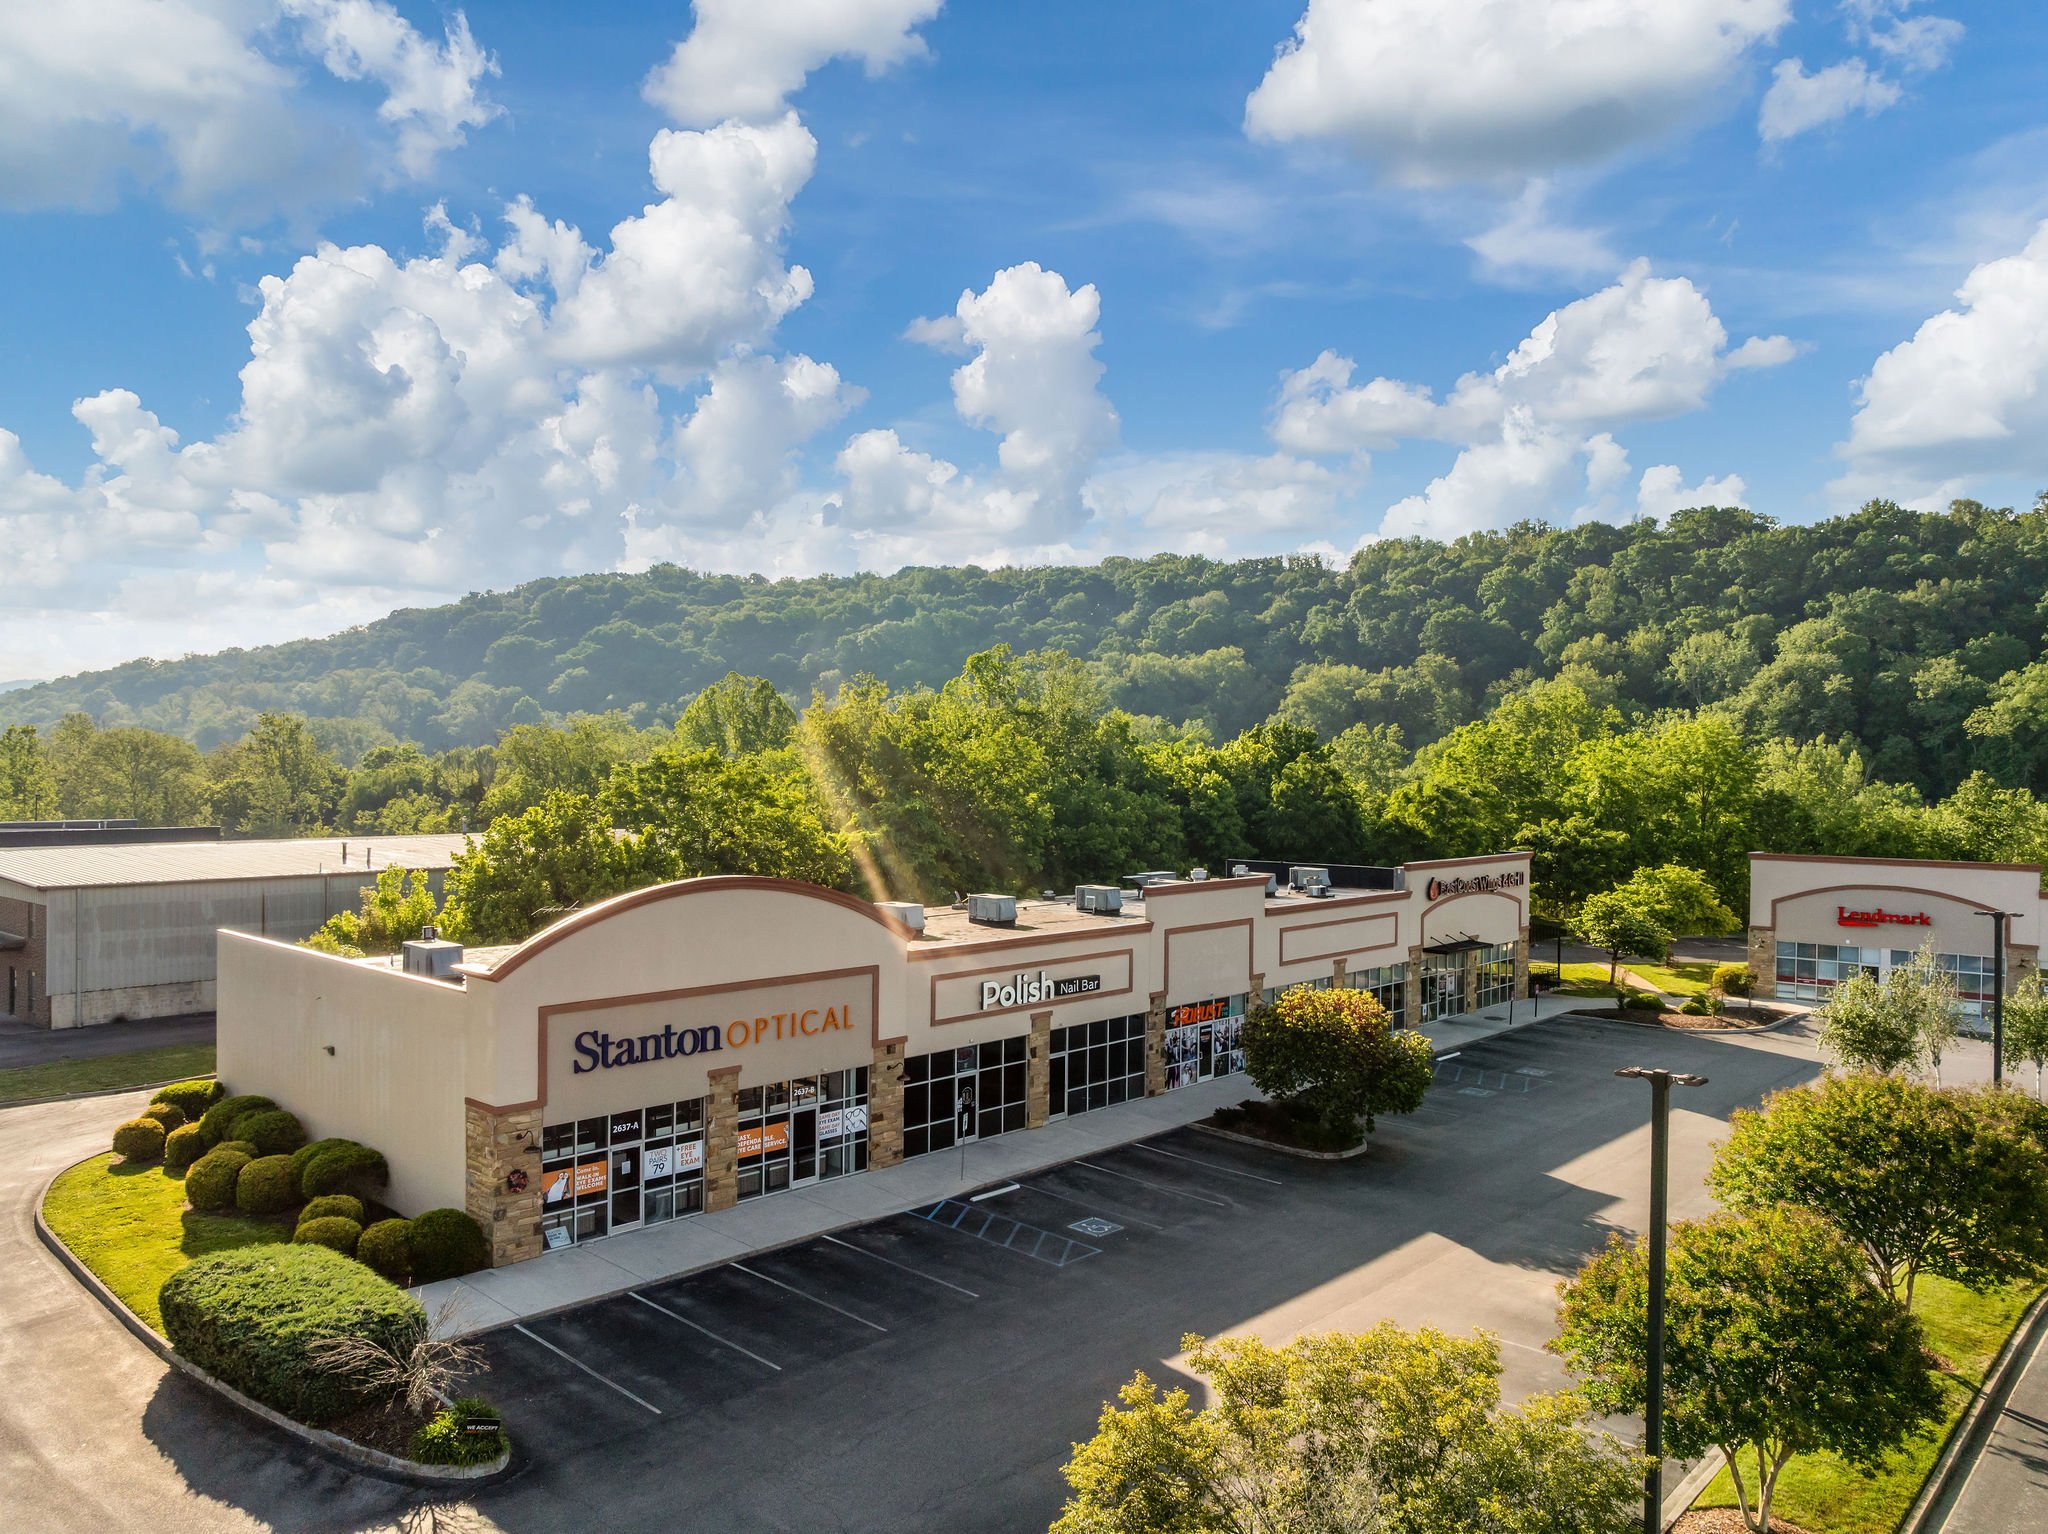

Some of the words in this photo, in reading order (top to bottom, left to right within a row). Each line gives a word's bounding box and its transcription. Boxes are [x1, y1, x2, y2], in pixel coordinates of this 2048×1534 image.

[1837, 906, 1931, 926] Lendmark
[981, 970, 1055, 1010] Polish
[1060, 981, 1079, 994] Nail
[1081, 979, 1099, 991] Bar
[573, 1024, 723, 1074] Stanton
[727, 1004, 855, 1048] OPTICAL
[793, 1086, 815, 1097] 2637-B
[612, 1121, 639, 1133] 2637-A
[747, 1144, 761, 1152] CARE
[680, 1150, 693, 1159] EYE
[648, 1155, 668, 1165] PAIRS
[680, 1156, 700, 1166] EXAM
[653, 1162, 665, 1175] 79
[587, 1175, 607, 1184] EXAMS
[576, 1181, 603, 1190] WELCOME
